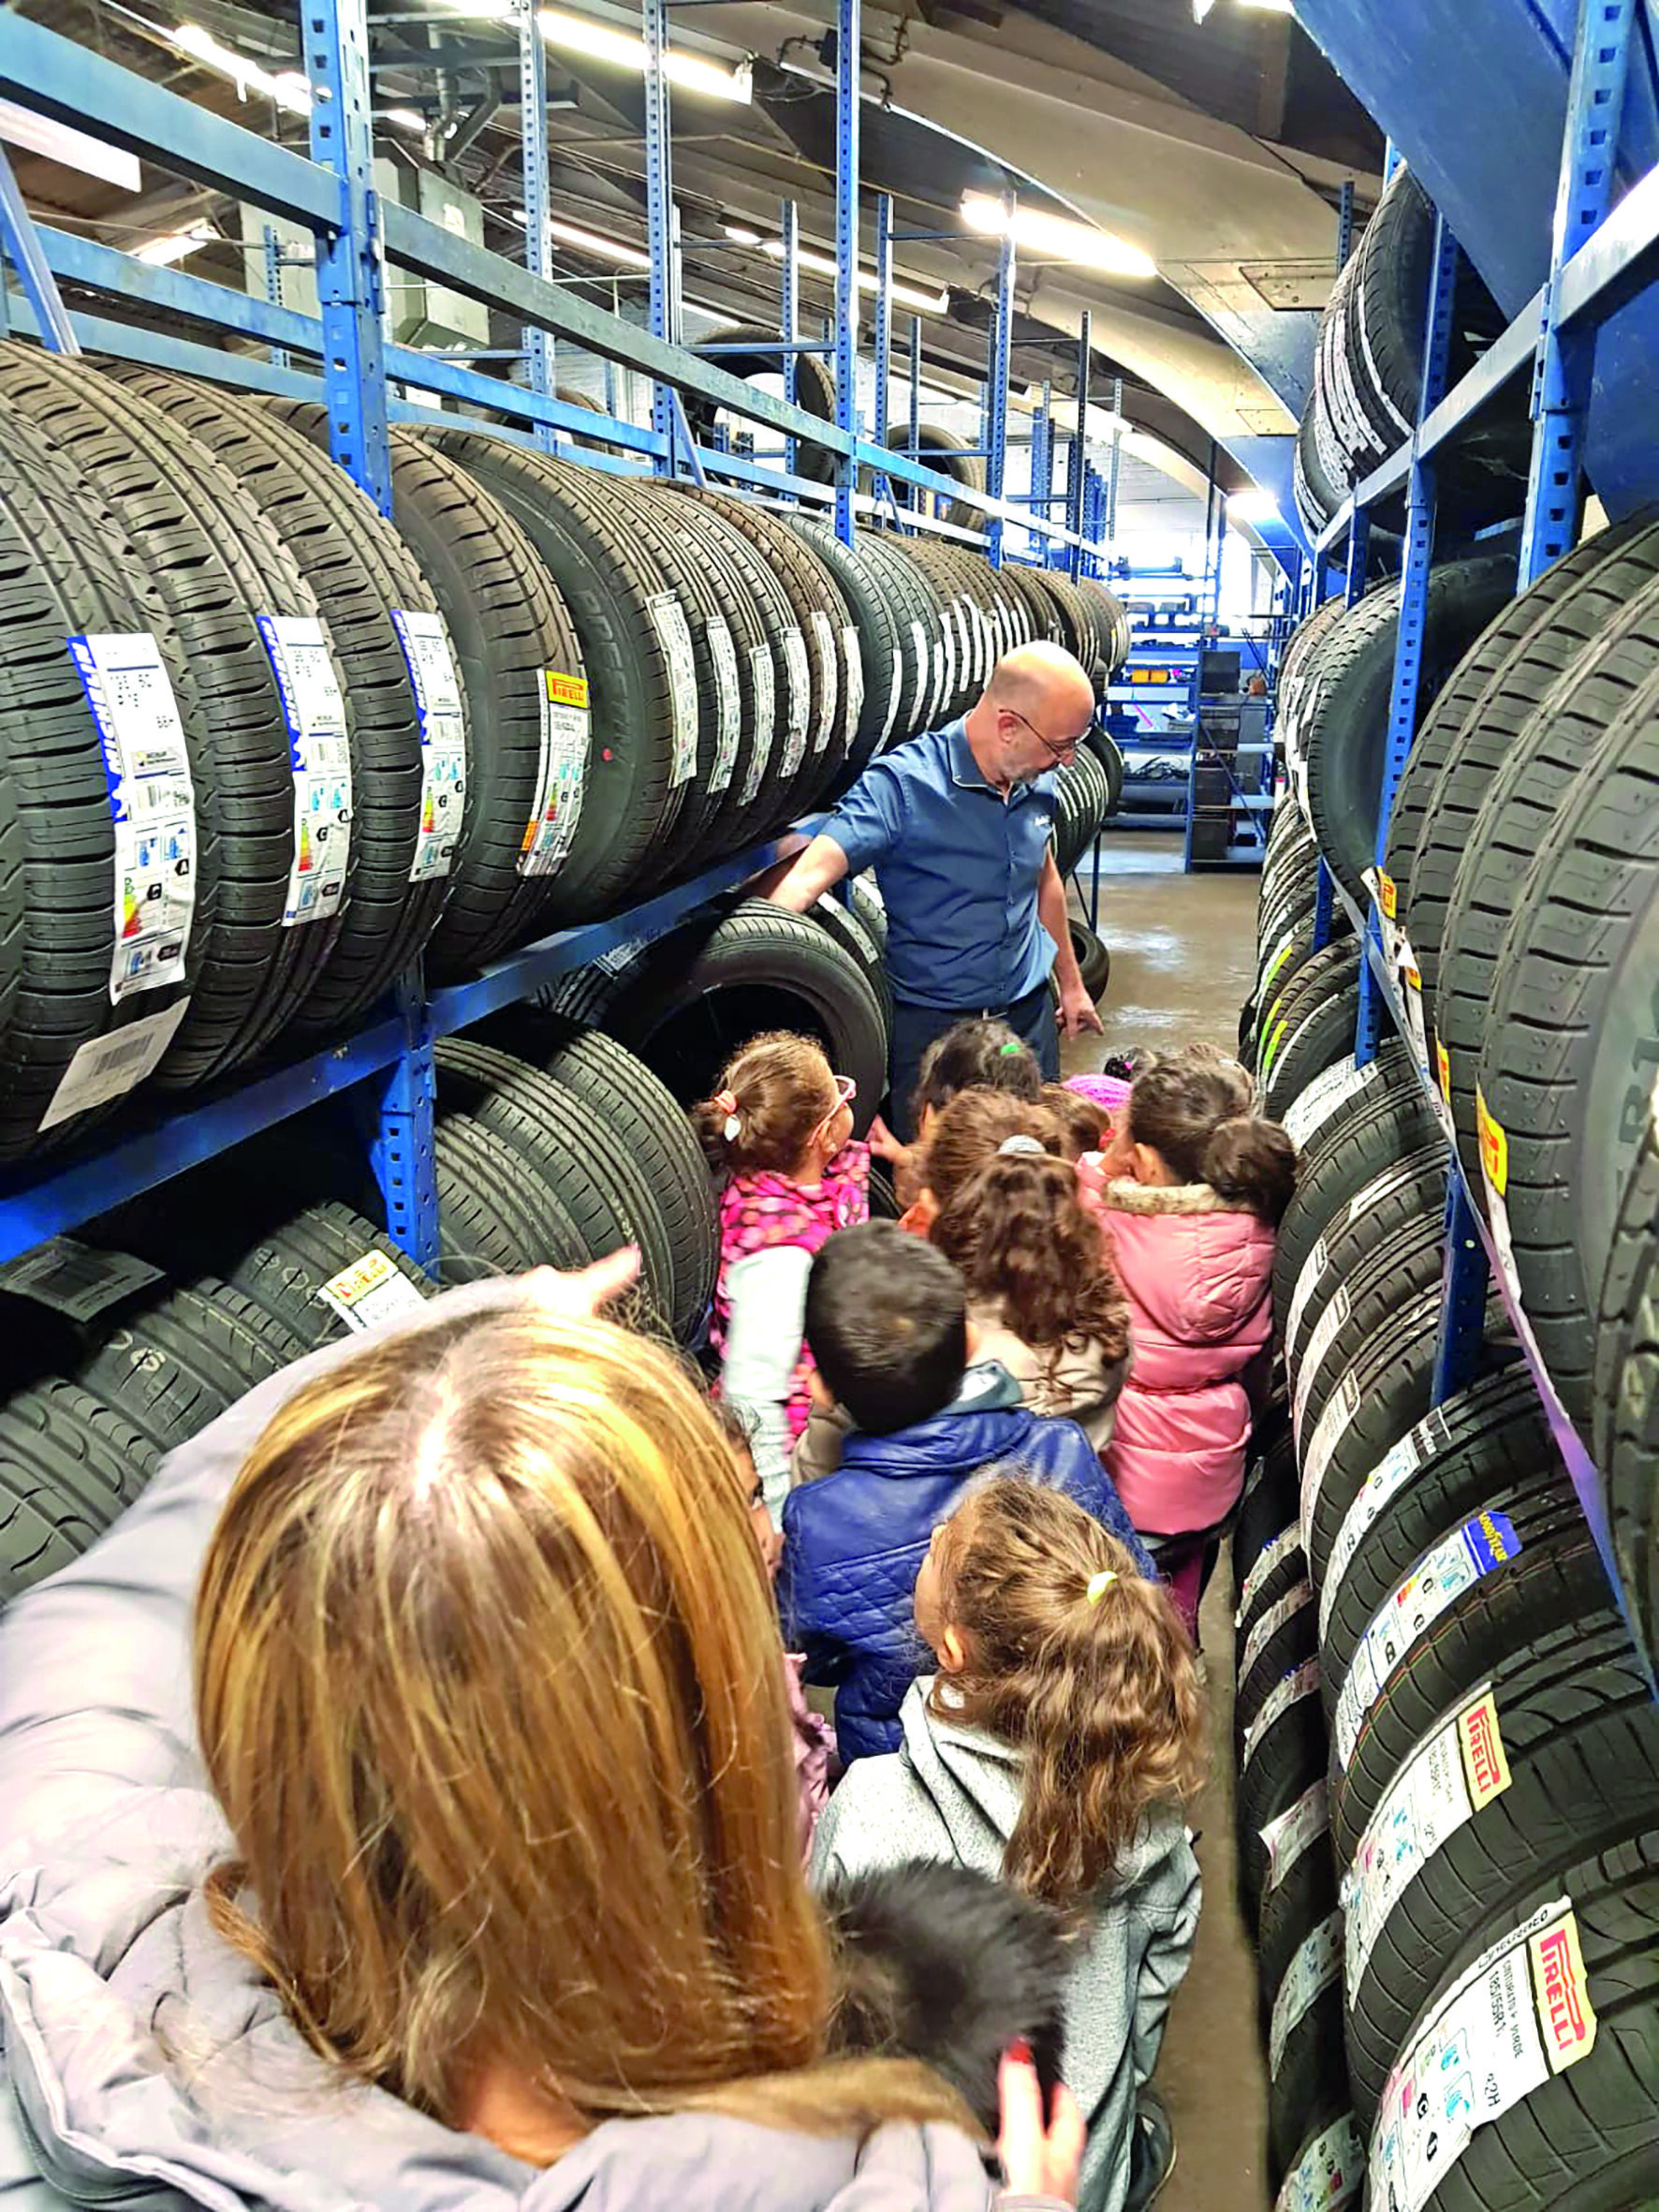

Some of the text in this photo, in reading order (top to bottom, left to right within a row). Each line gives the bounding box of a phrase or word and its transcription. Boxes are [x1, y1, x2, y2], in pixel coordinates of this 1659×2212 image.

[71, 642, 123, 775] MICHELIN
[261, 620, 301, 732] MICHELIN
[393, 613, 428, 710] MICHELIN
[551, 678, 584, 701] PIRELLI
[1466, 1705, 1501, 1793] PIRELLI
[1489, 1969, 1505, 2038] 185/55R1
[1539, 1928, 1585, 2051] PIRELLI
